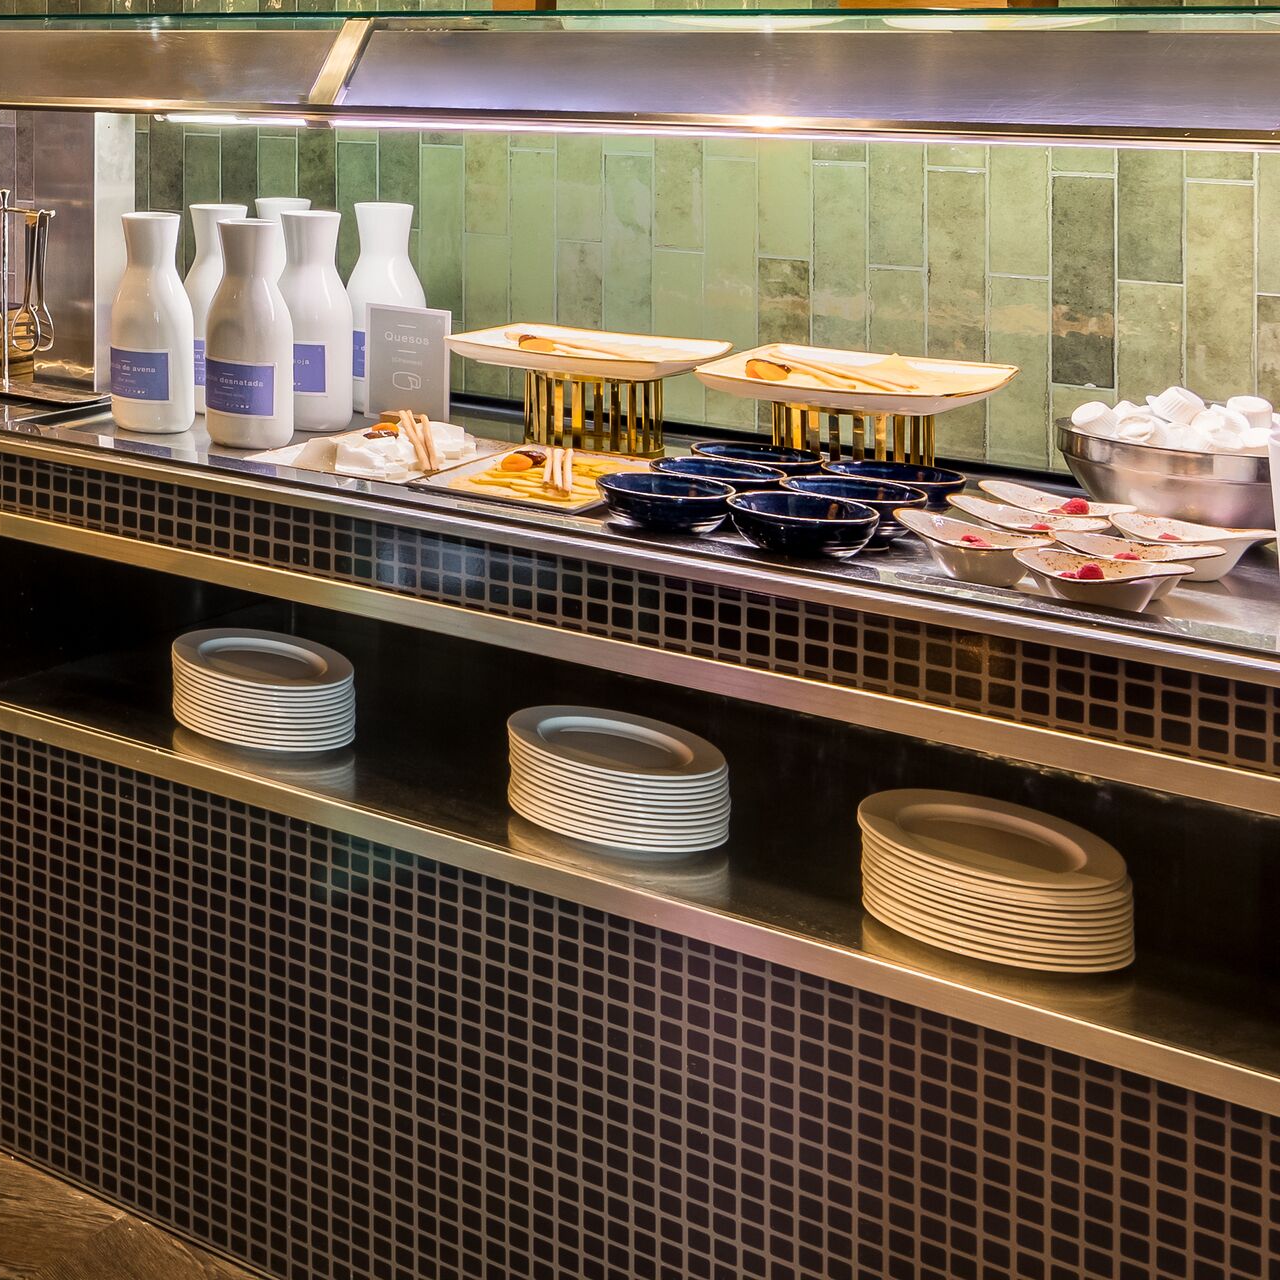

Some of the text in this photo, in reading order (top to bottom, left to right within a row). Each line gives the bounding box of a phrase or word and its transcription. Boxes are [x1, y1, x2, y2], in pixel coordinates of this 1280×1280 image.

[384, 331, 430, 346] Quesos
[132, 366, 156, 374] avena
[219, 376, 264, 388] desnatada
